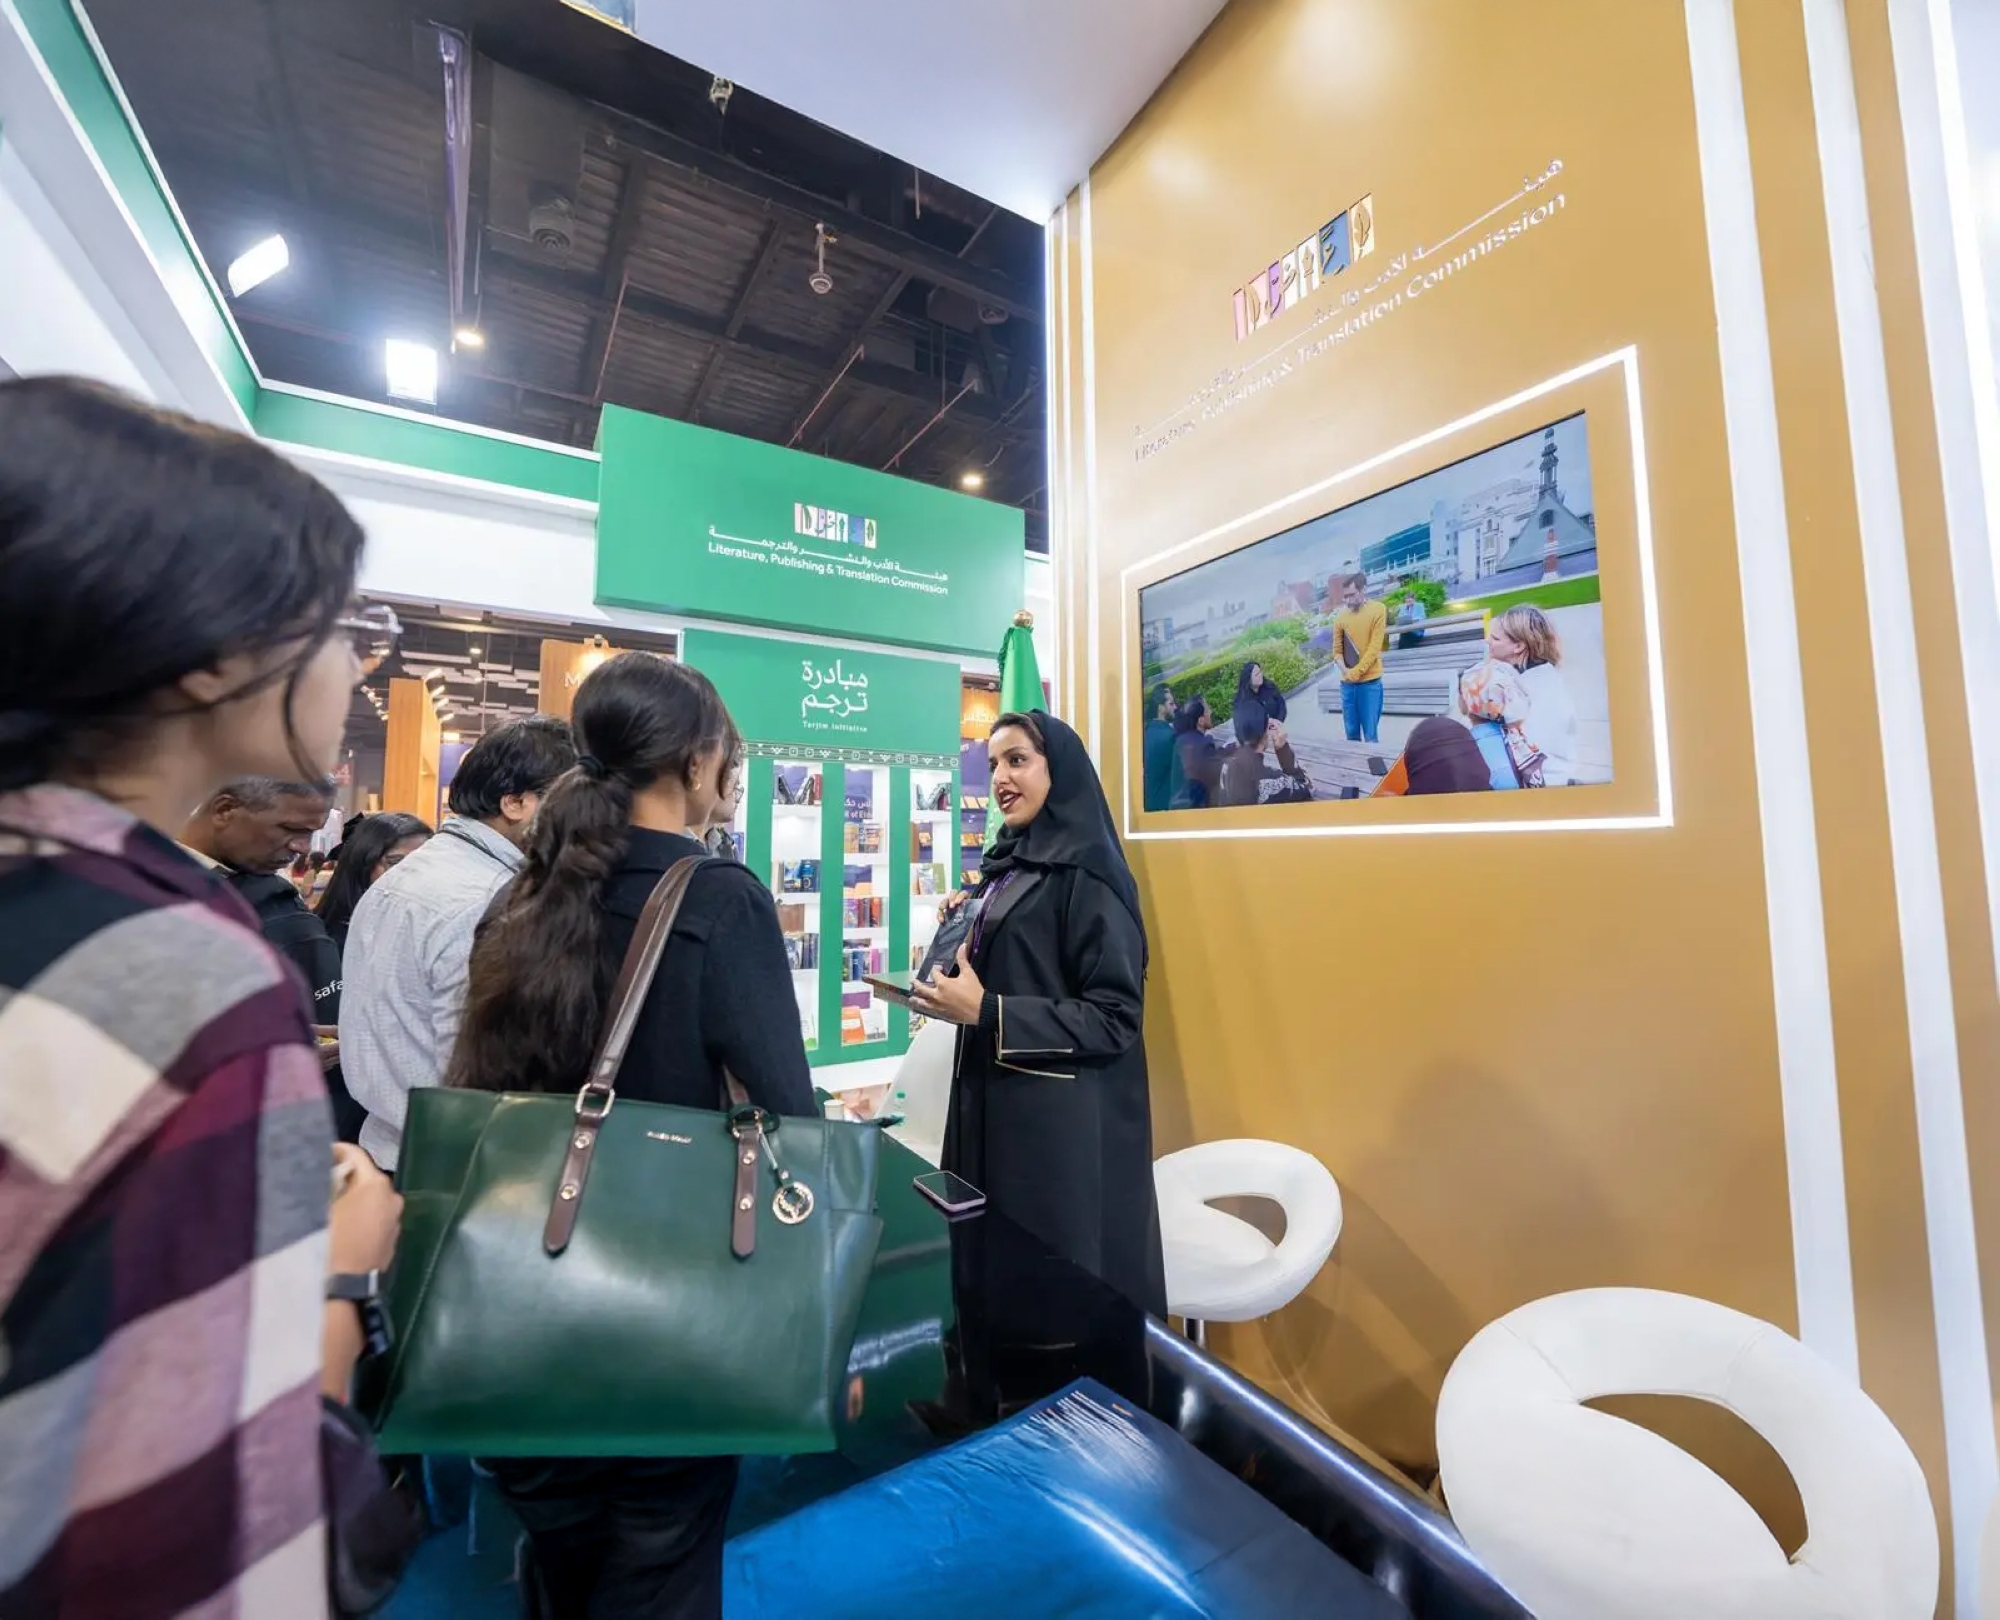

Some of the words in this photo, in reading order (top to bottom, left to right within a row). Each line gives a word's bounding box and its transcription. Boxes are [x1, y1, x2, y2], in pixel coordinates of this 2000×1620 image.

[1297, 292, 1402, 364] Translation
[1406, 193, 1566, 298] Commission
[708, 541, 769, 564] Literature,
[770, 552, 825, 575] Publishing
[825, 563, 835, 575] &
[835, 564, 890, 585] Translation
[891, 576, 949, 595] Commission
[801, 658, 869, 691] مبادرة
[801, 691, 869, 719] ترجم
[314, 979, 345, 1001] safa
